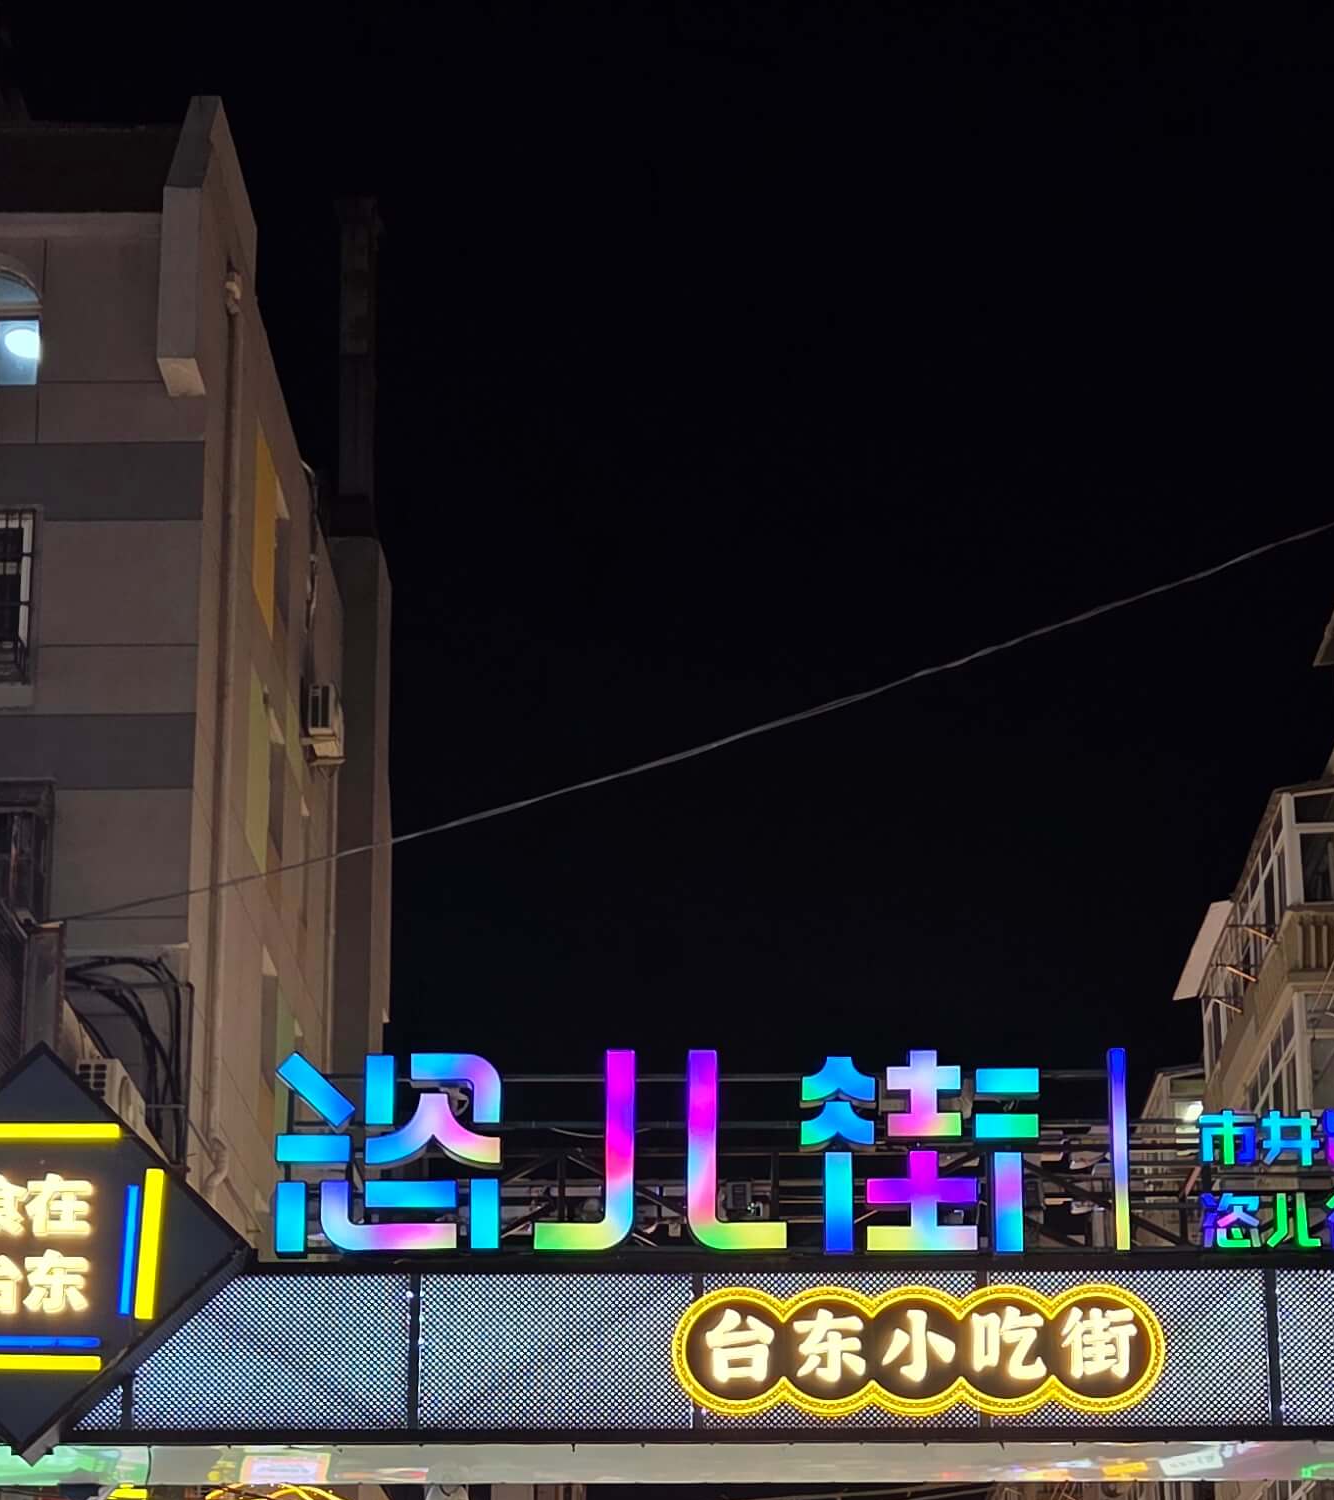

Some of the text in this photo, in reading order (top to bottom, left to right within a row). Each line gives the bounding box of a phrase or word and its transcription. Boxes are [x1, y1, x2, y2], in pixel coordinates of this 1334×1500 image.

[275, 1049, 1041, 1254] 恣儿街
[703, 1306, 1138, 1384] 台东小吃街
